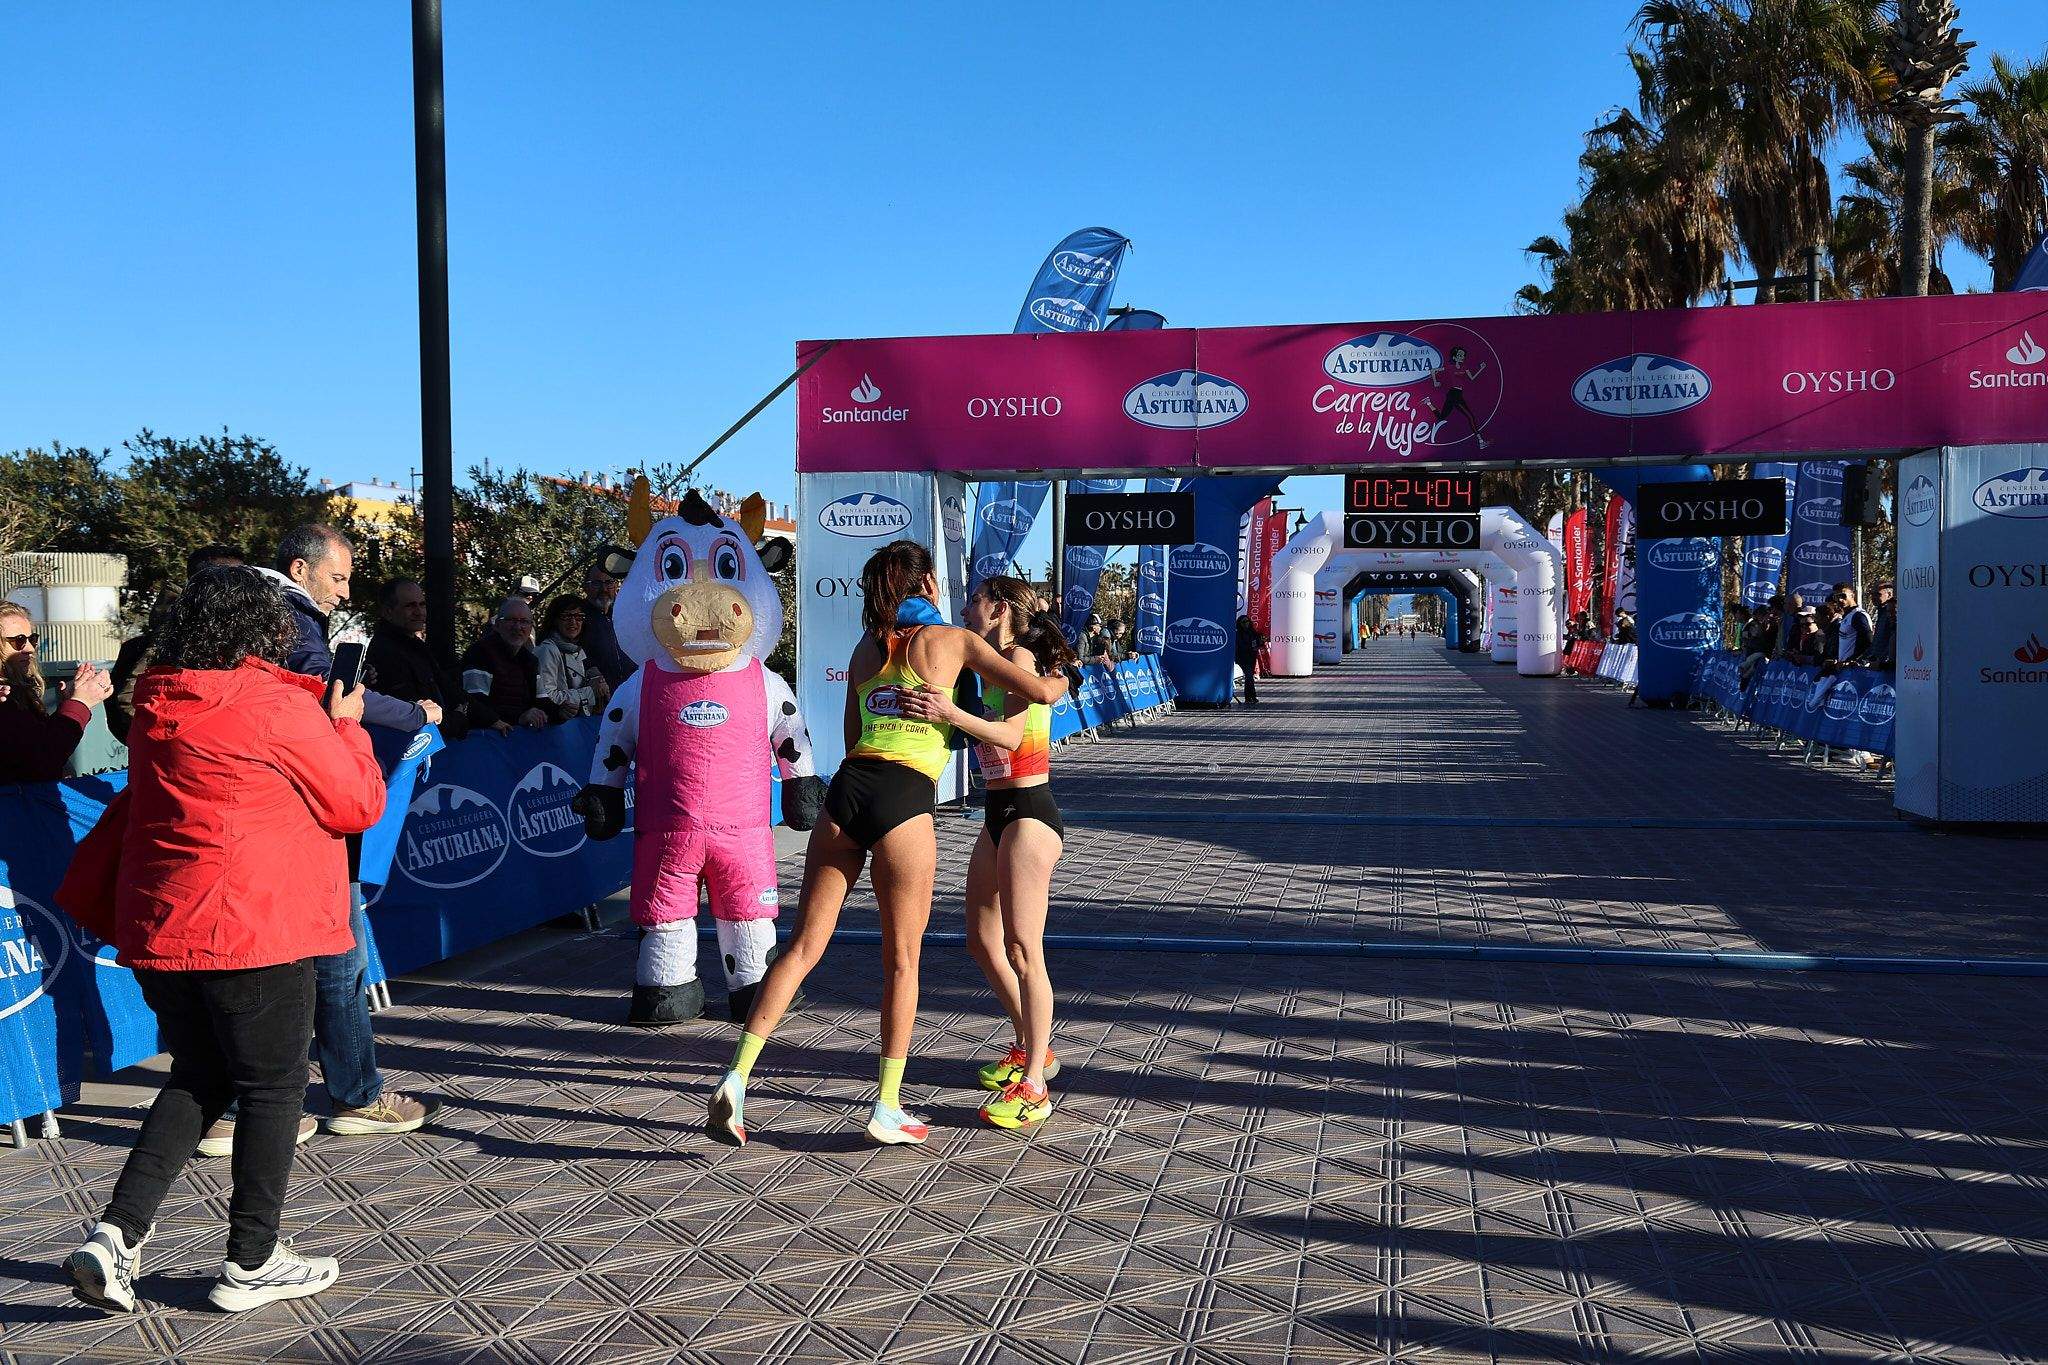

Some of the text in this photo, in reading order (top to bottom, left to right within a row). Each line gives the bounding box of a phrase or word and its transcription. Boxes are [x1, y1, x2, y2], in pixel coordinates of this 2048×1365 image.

[1035, 303, 1093, 330] ASTURIANA
[1390, 349, 1430, 357] LECHERA
[1332, 353, 1434, 374] ASTURIANA
[1603, 373, 1696, 383] CENTRAL LECHERA
[1782, 367, 1896, 394] OYSHO
[1969, 369, 2048, 388] Santan
[1151, 389, 1192, 397] CENTRAL
[1312, 384, 1411, 413] Carrera
[1583, 379, 1700, 402] ASTURIANA
[967, 396, 1062, 418] OYSHO
[1132, 392, 1239, 415] ASTURIANA
[822, 406, 910, 423] Santander
[1336, 408, 1448, 456] de la Mujer
[1353, 479, 1472, 507] 00:24:04
[825, 509, 906, 527] ASTURIANA
[1086, 509, 1176, 530] OYSHO
[1661, 498, 1764, 522] OYSHO
[1350, 519, 1474, 544] OYSHO
[1252, 516, 1264, 575] Santander
[1291, 547, 1325, 555] OYSHO
[1504, 541, 1539, 550] OYSHO
[1574, 525, 1584, 578] Santander
[1797, 548, 1849, 562] ASTURIANA
[1169, 555, 1226, 570] ASTURIANA
[1370, 572, 1438, 580] VOLVO
[1902, 565, 1935, 590] OYSHO
[816, 577, 864, 598] OYS
[1275, 591, 1306, 599] OYSHO
[1523, 588, 1556, 596] OYSHO
[1167, 629, 1223, 644] ASTURIANA
[1274, 635, 1305, 644] OYSHO
[1523, 634, 1556, 642] OYSHO
[682, 710, 726, 720] ASTURIANA
[899, 723, 904, 731] Y
[418, 809, 495, 835] CENTRAL LECHERA
[406, 823, 505, 871] ASTURIANA
